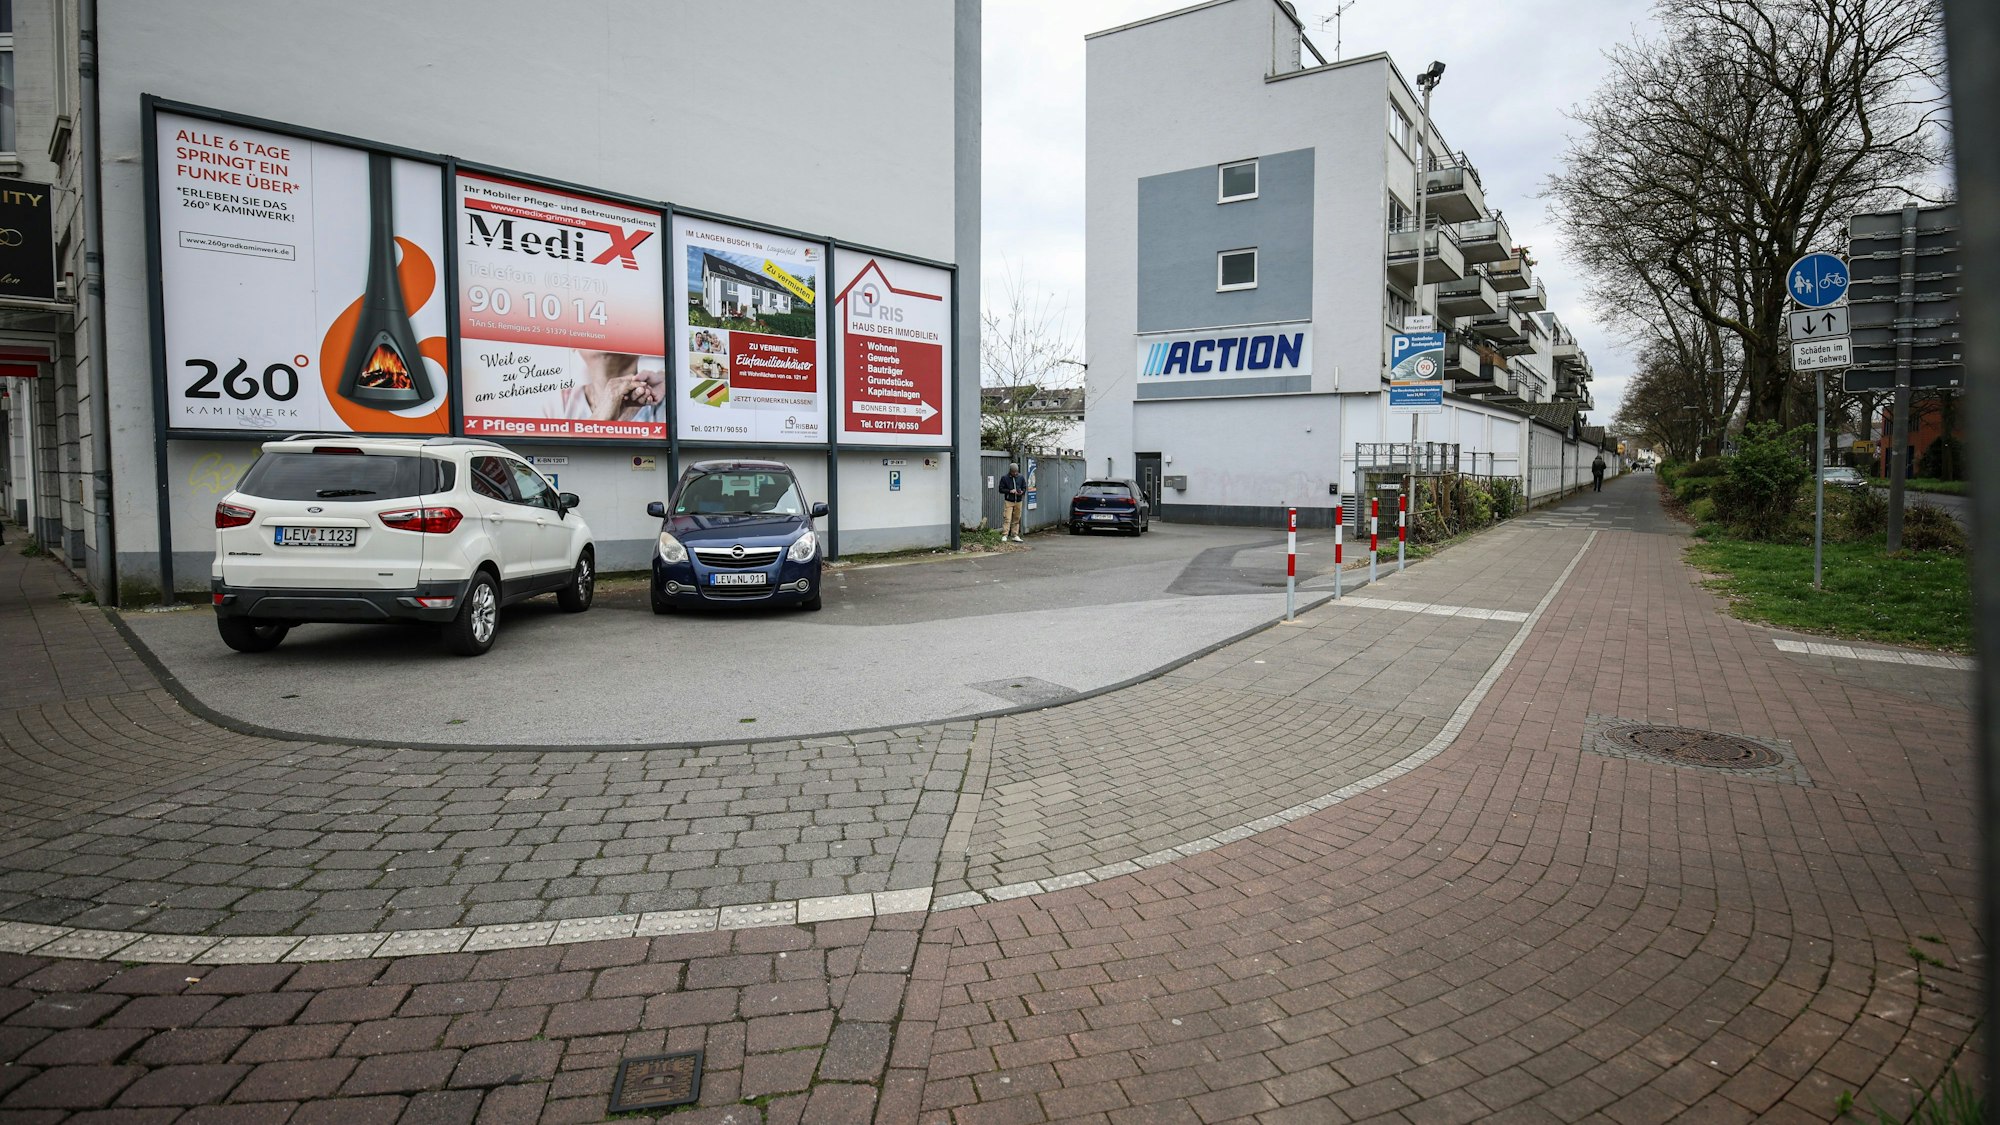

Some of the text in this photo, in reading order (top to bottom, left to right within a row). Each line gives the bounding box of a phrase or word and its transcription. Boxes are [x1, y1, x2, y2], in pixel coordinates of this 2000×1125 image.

[176, 130, 290, 160] ALLE 6 TAGE
[176, 147, 288, 177] SPRINGT EIN
[177, 164, 241, 186] FUNKE
[182, 198, 295, 222] 260° KAMINWERK!
[242, 196, 260, 207] SIE
[264, 200, 287, 211] DAS
[464, 185, 656, 228] Ihr Mobiler Pflege- und Betreuungsdienst
[490, 204, 587, 226] www.medix-grimm.de
[186, 237, 290, 255] www.260gradkaminwerk.de
[696, 232, 725, 243] LANGEN
[727, 237, 750, 247] BUSCH
[752, 242, 763, 250] 19a
[468, 260, 608, 295] Telefon (02171)
[766, 264, 811, 300] Zu vermieten
[468, 285, 608, 326] 90 10 14
[879, 306, 904, 322] RIS
[498, 322, 530, 333] Remigius
[569, 330, 606, 340] Leverkusen
[852, 322, 938, 340] HAUS DER IMMOBILIEN
[759, 344, 799, 354] VERMIETEN:
[868, 341, 897, 353] Wohnen
[1163, 333, 1304, 375] ACTION
[1394, 337, 1409, 357] P
[1801, 346, 1830, 355] Schäden
[480, 352, 531, 368] Weil es
[736, 354, 813, 371] Einfamilienhäuser
[868, 353, 900, 365] Gewerbe
[1798, 355, 1846, 365] Rad- Gehweg
[503, 365, 563, 382] zu Hause
[868, 364, 903, 376] Bauträger
[475, 378, 576, 403] am schönsten ist
[868, 376, 914, 388] Grundstücke
[868, 387, 920, 400] Kapitalanlagen
[186, 406, 298, 417] KAMINWERK
[861, 404, 887, 412] BONNER
[903, 406, 906, 414] 3
[483, 419, 536, 433] Pflege
[540, 422, 569, 433] und
[574, 423, 650, 437] Betreuung
[861, 420, 873, 428] Tel.
[891, 472, 899, 484] P
[284, 529, 310, 541] LEV
[319, 530, 325, 541] I
[329, 530, 353, 541] 123
[716, 575, 764, 583] LEV NL 911
